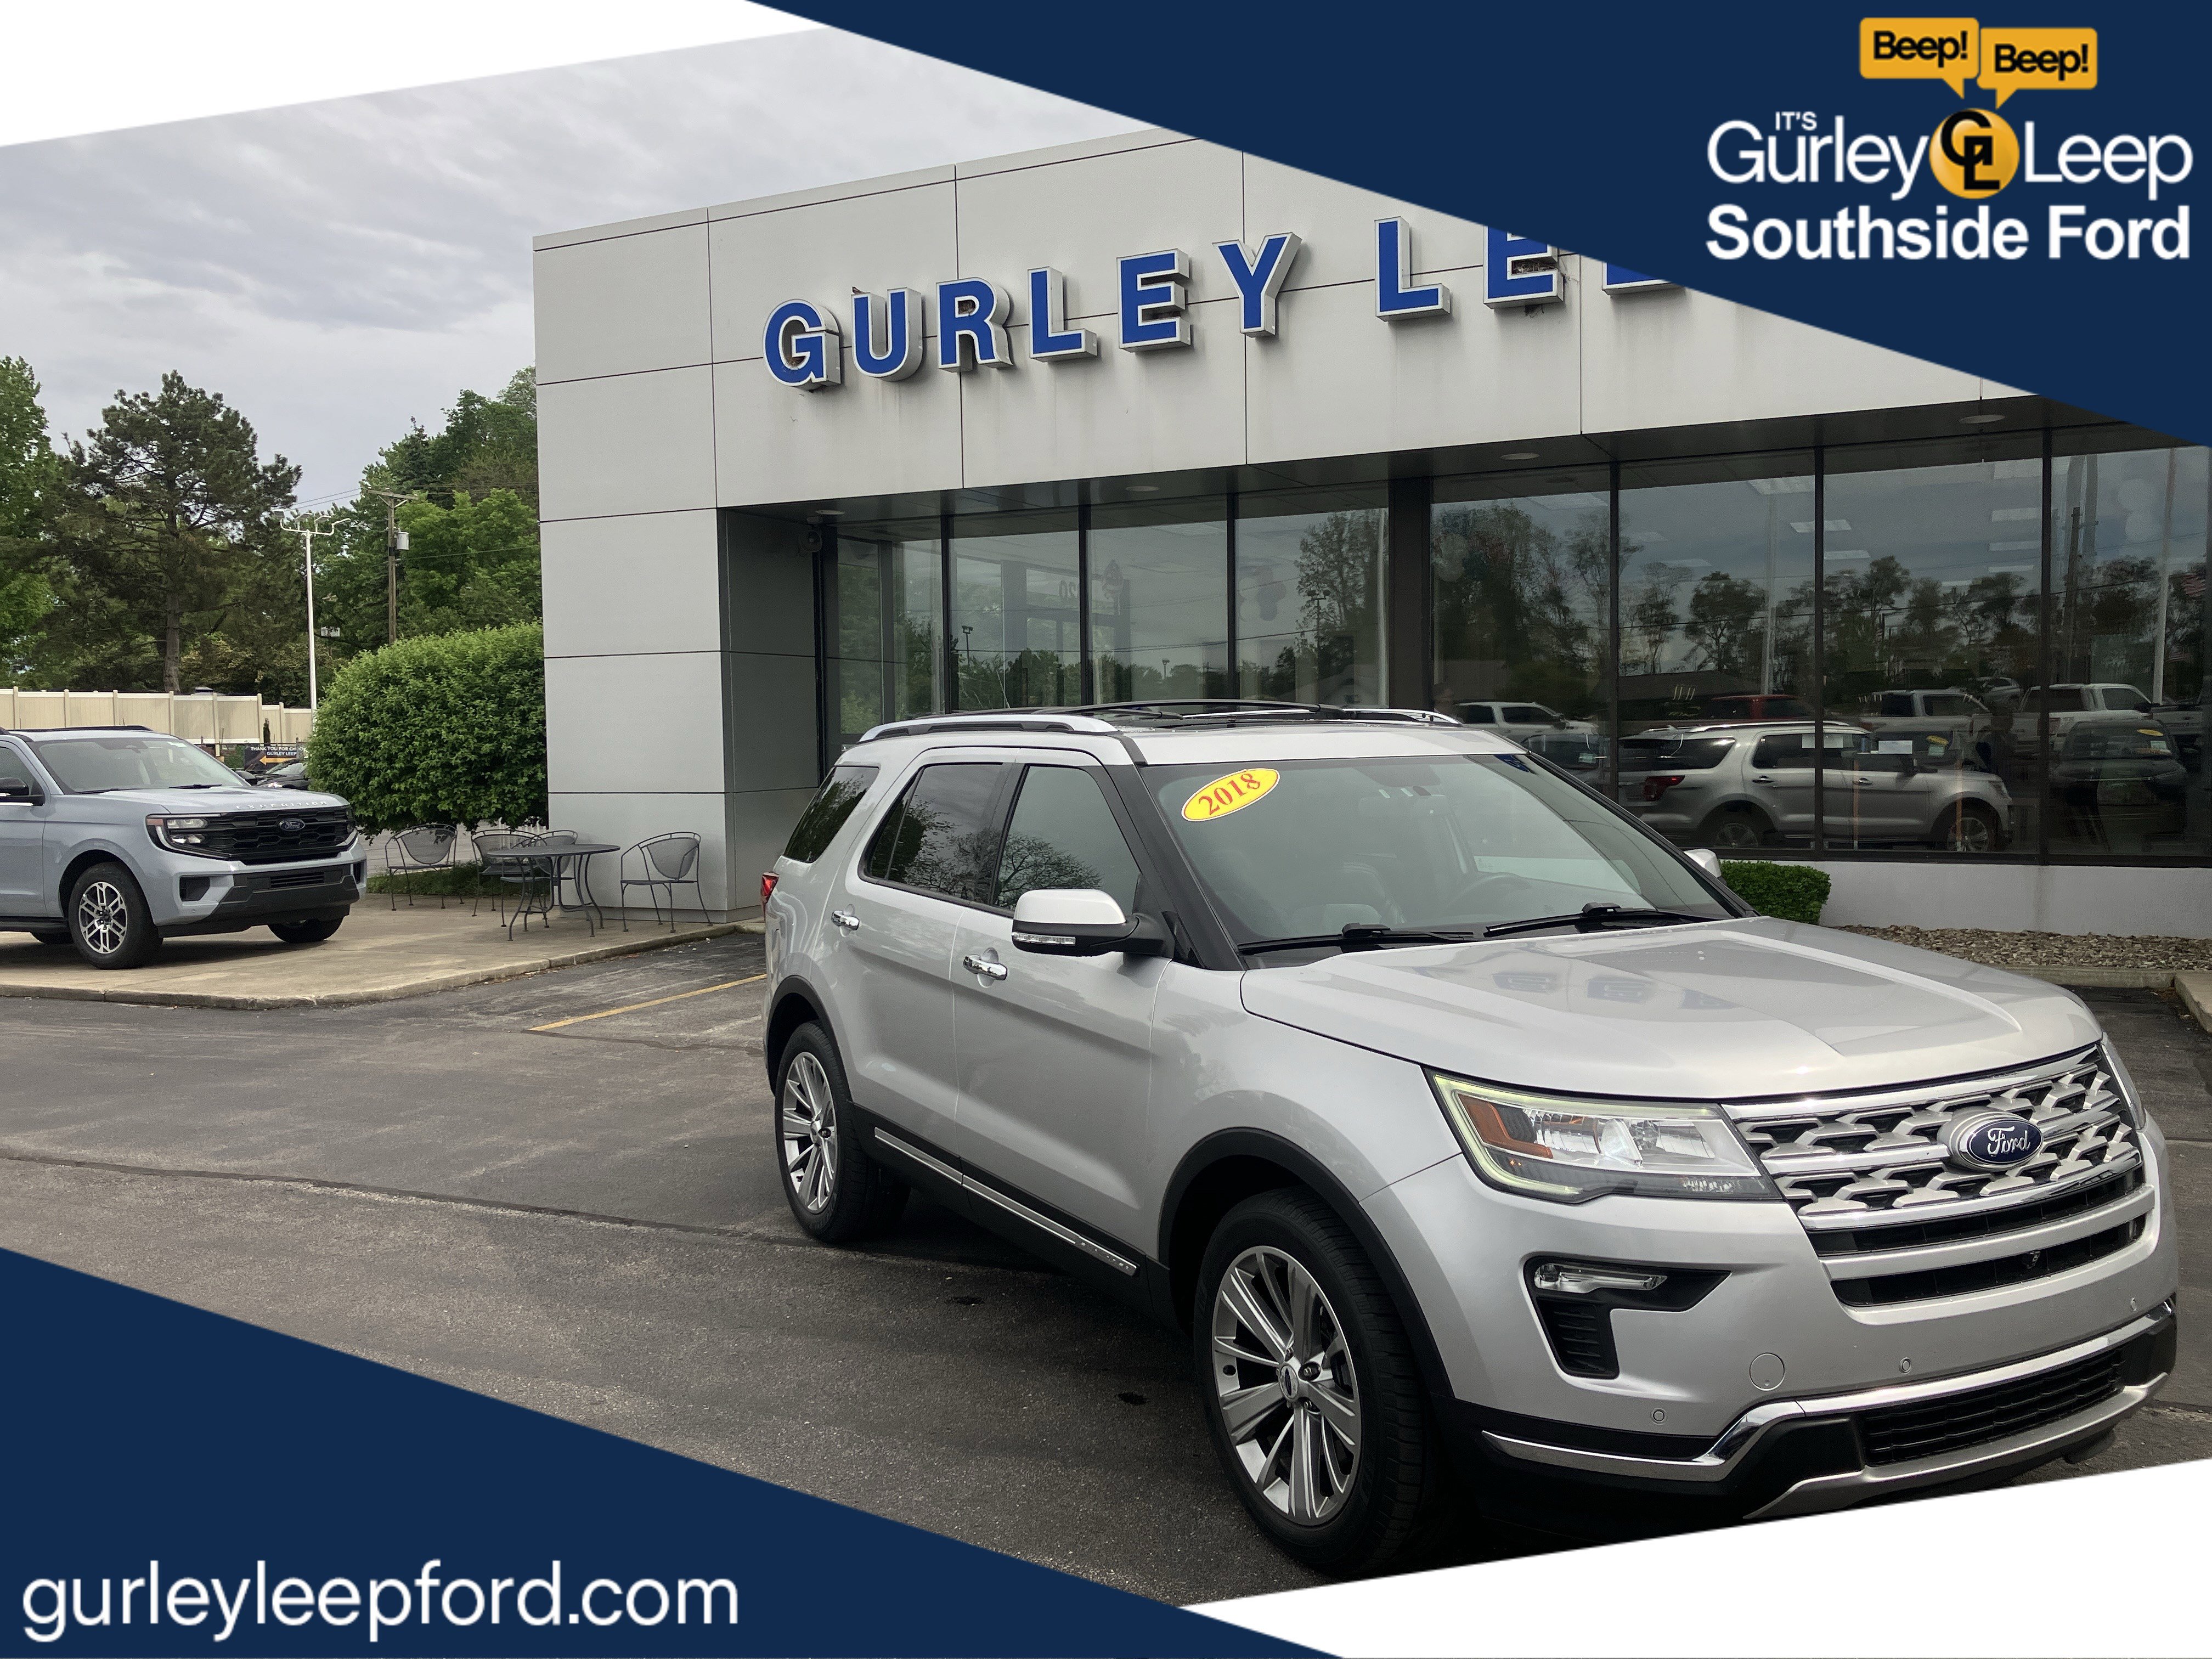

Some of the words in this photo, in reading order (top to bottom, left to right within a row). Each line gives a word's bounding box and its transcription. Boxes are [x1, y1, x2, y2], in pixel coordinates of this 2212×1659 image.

[763, 232, 1302, 391] GURLEY
[236, 800, 328, 810] EXPEDITION
[1198, 772, 1261, 815] 2018
[1987, 1126, 2031, 1157] Ford
